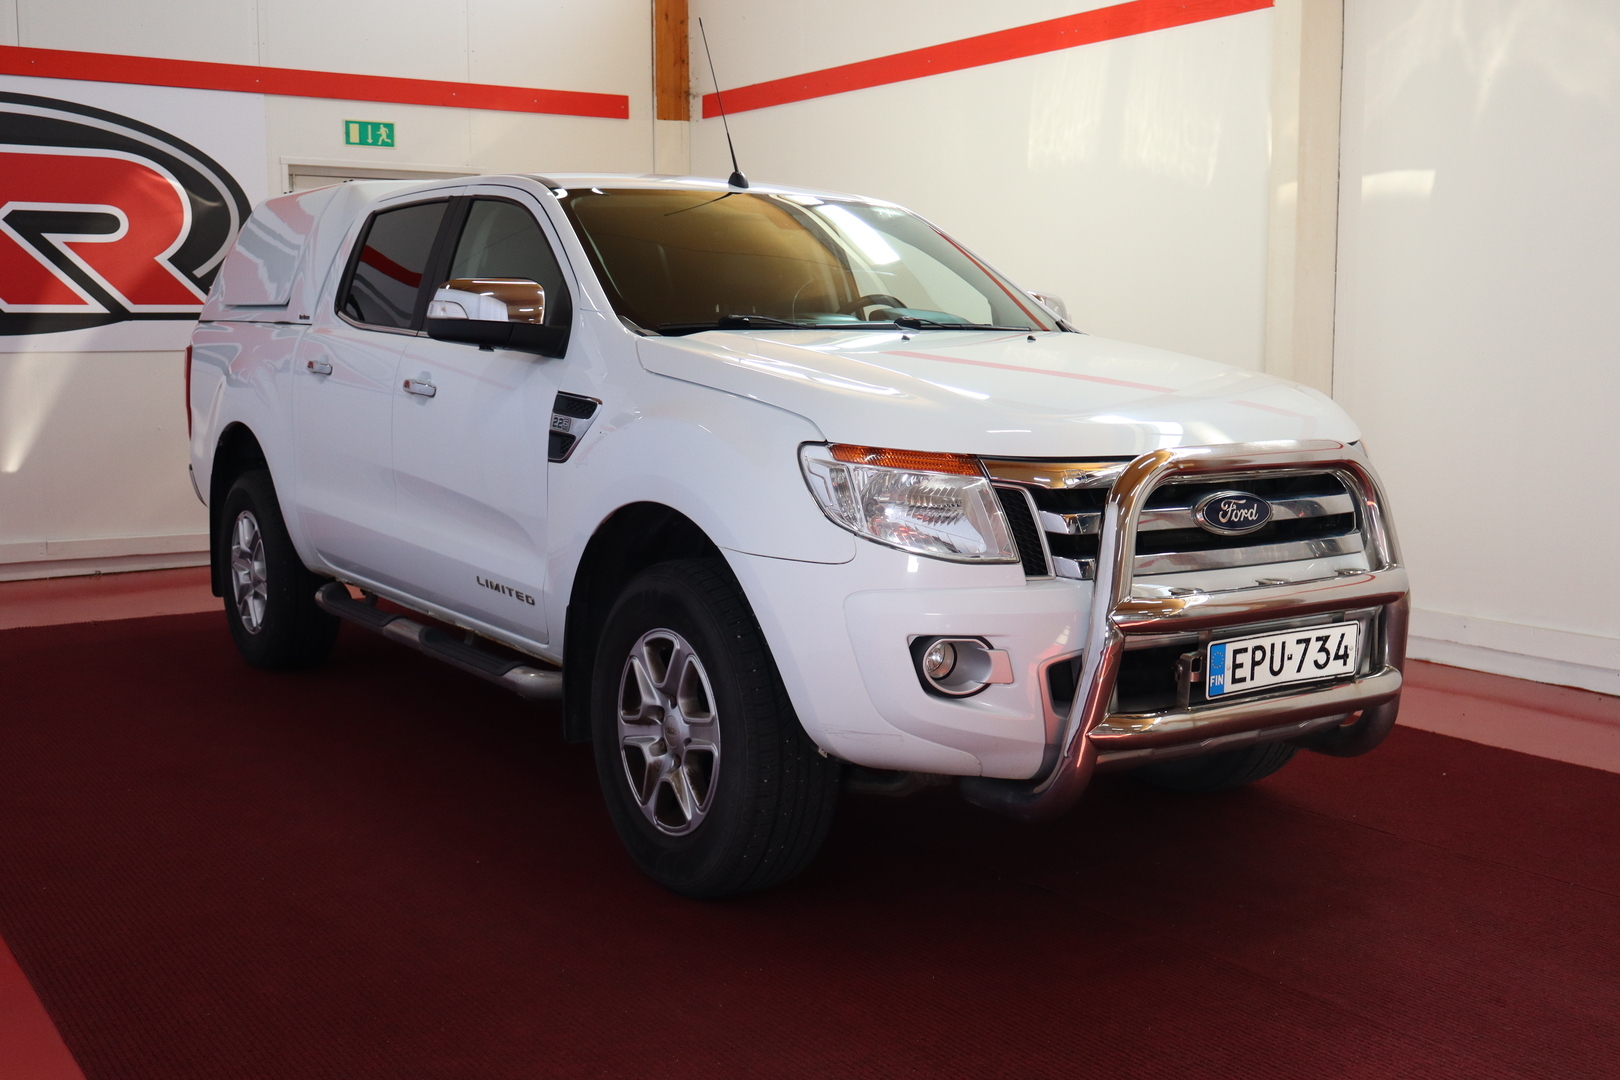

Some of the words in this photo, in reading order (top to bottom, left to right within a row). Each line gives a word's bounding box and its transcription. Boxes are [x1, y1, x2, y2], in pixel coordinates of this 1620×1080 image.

[1218, 498, 1259, 523] Ford
[476, 575, 535, 606] LIMITED
[1230, 633, 1349, 685] EPU-734
[1209, 674, 1224, 687] FIN
